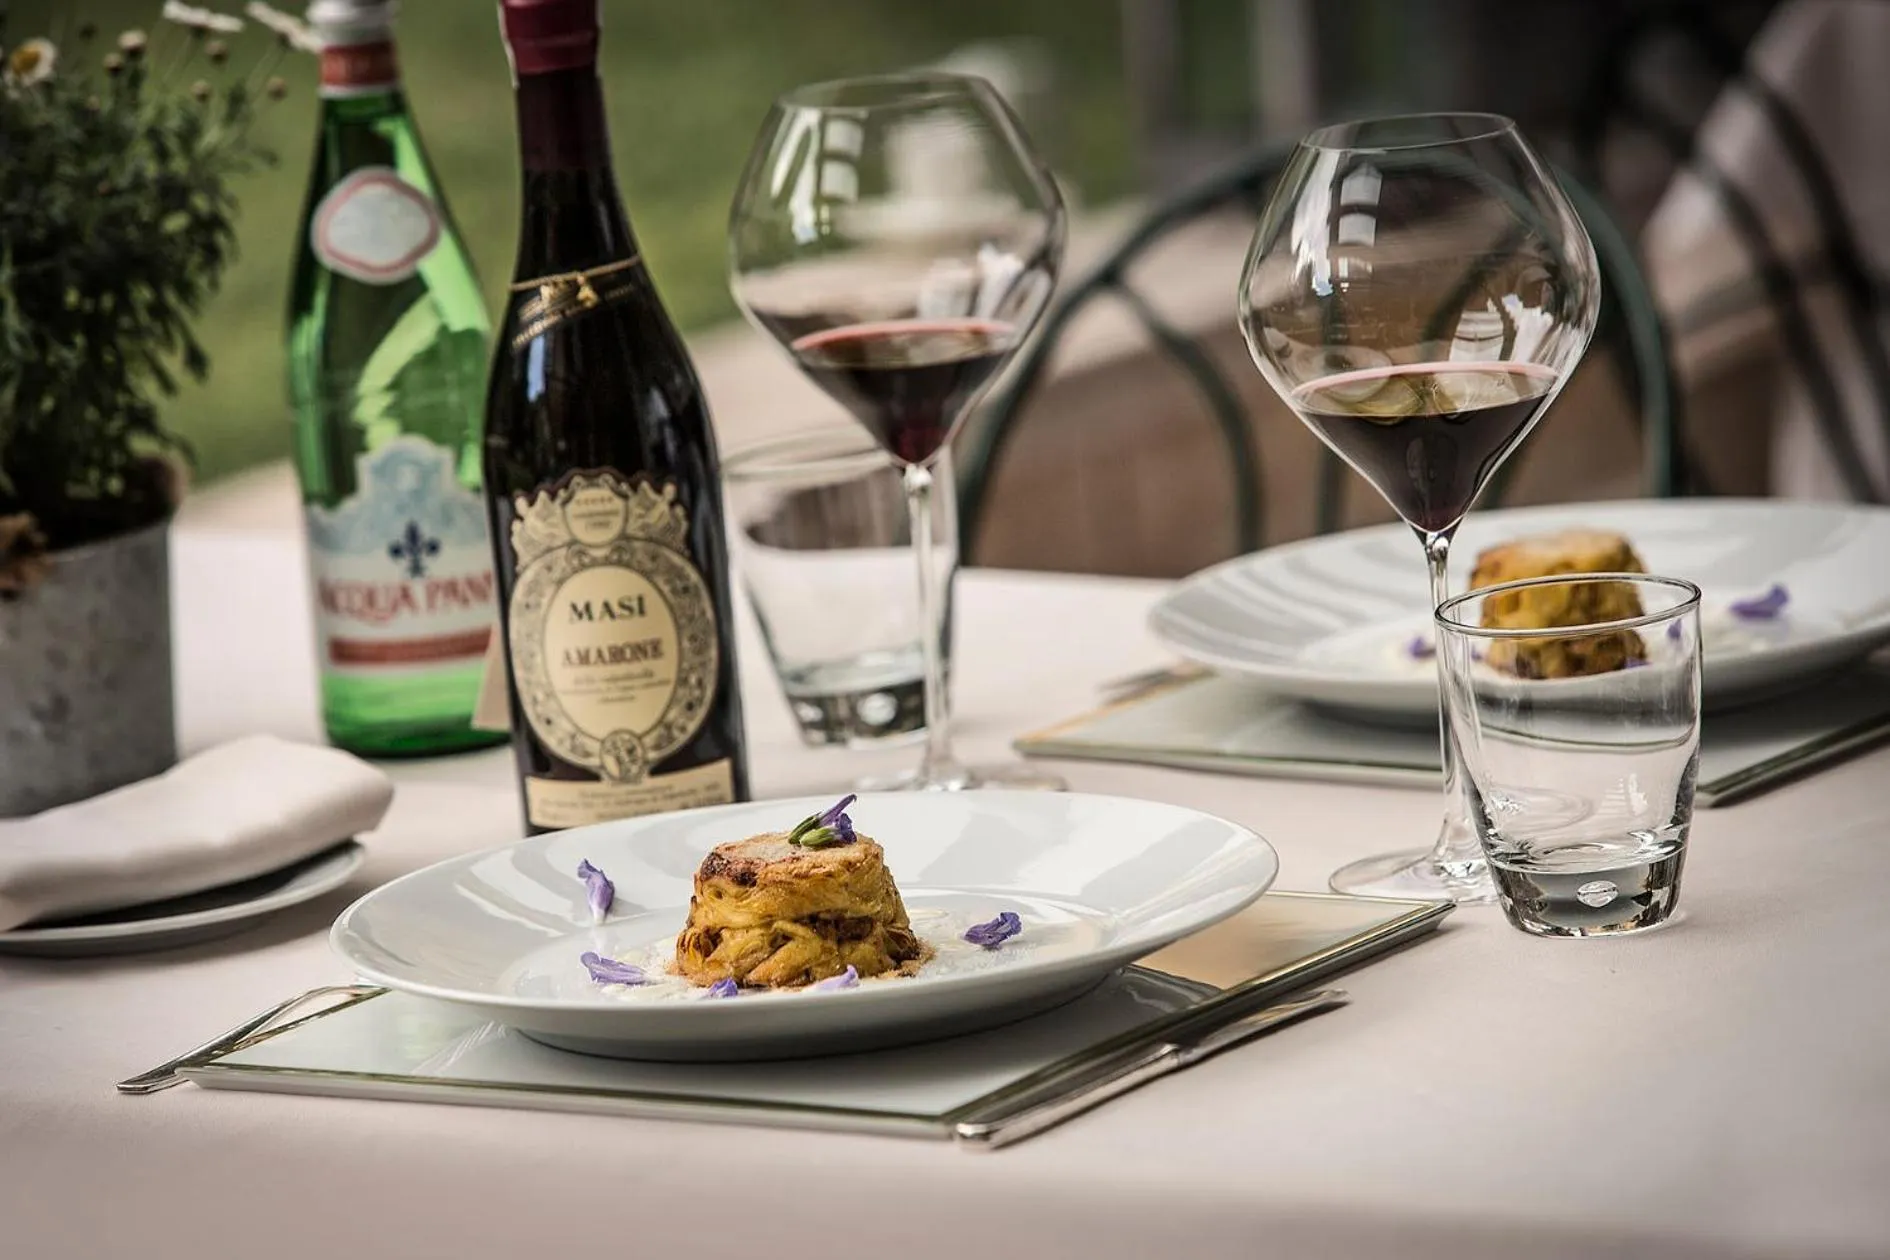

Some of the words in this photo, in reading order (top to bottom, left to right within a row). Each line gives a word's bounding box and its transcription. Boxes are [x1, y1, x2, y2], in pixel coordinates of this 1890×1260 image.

[318, 577, 419, 623] ACQUA
[427, 569, 491, 614] PAN
[568, 594, 647, 624] MASI
[562, 638, 664, 667] AMARONE
